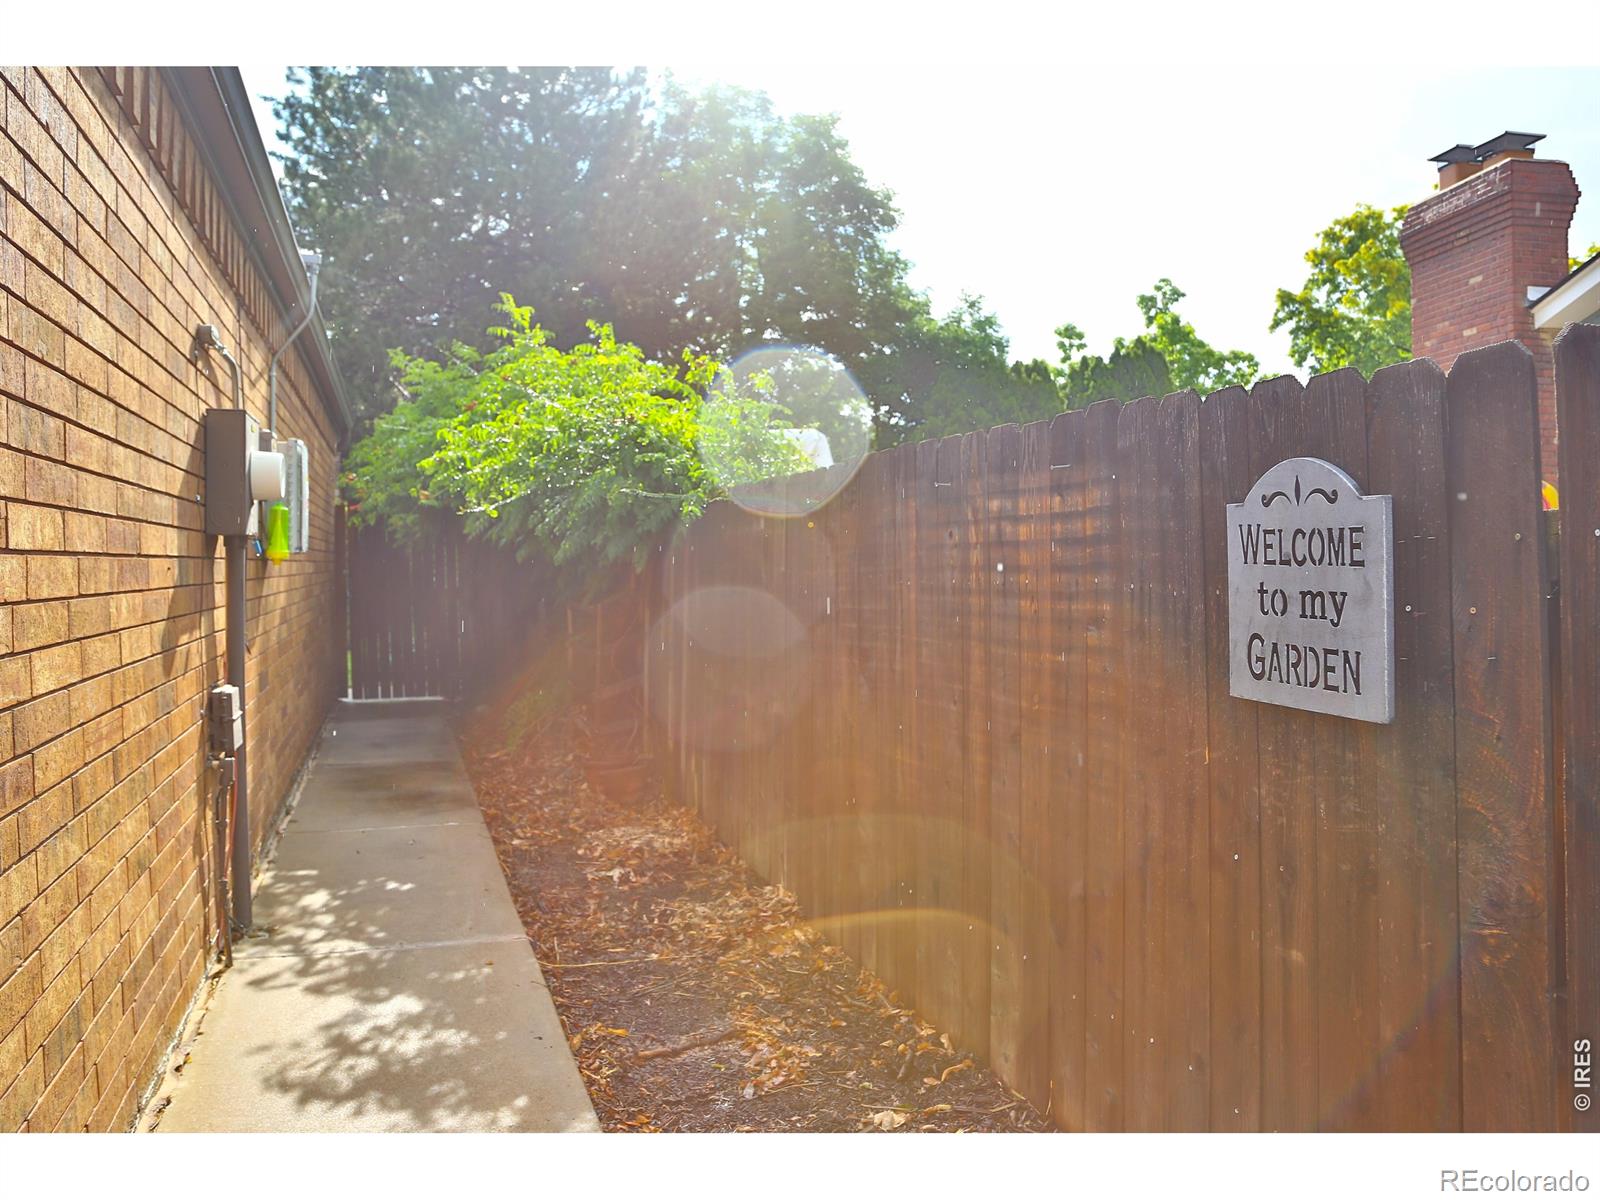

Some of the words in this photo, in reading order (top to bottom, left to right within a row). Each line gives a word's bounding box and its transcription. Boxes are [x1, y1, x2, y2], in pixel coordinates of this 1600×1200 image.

[1238, 523, 1366, 568] WELCOME
[1257, 581, 1288, 617] to
[1299, 589, 1348, 628] my
[1247, 632, 1362, 695] GARDEN
